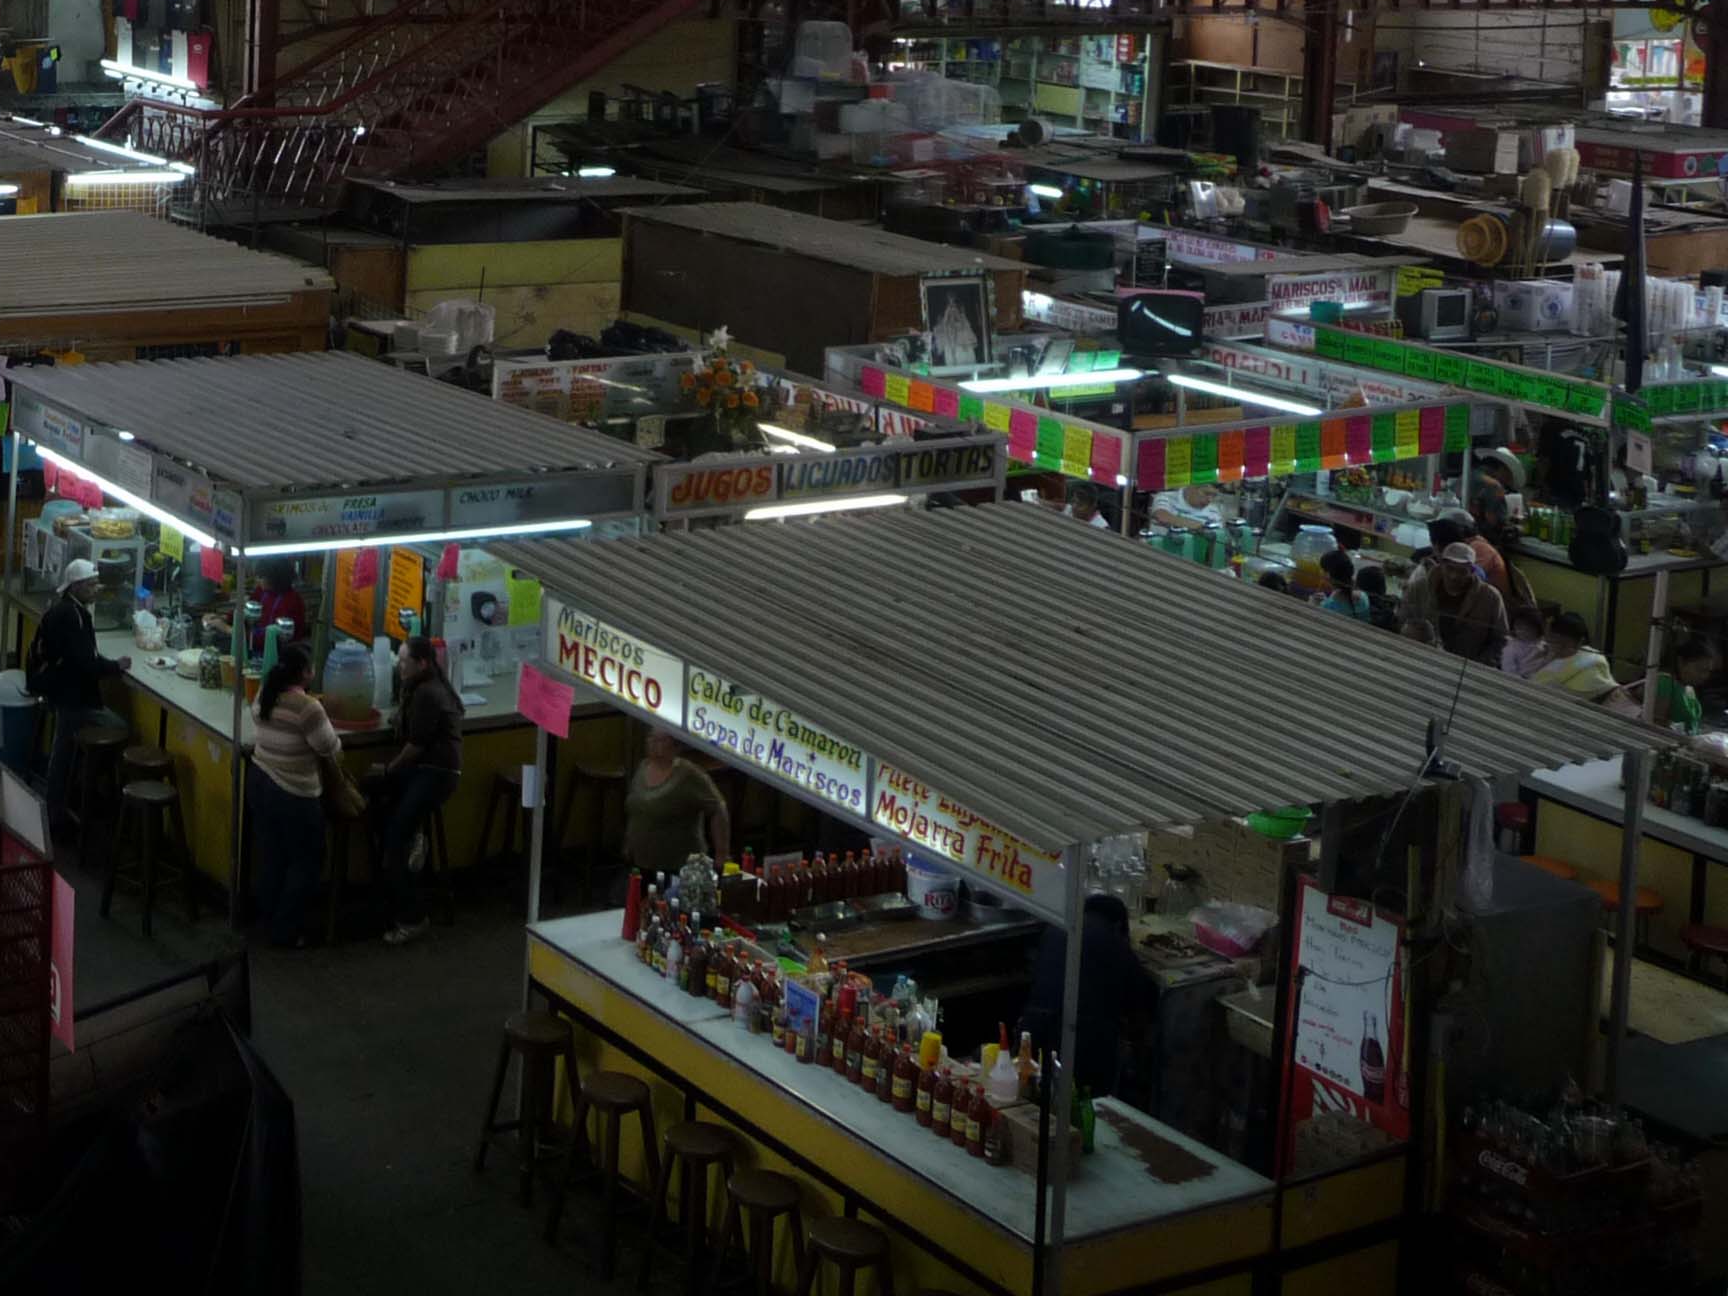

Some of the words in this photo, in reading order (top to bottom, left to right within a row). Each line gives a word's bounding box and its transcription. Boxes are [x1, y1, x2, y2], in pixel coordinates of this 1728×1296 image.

[1273, 279, 1337, 299] MARISCOS
[1348, 276, 1377, 293] MAR
[342, 496, 377, 511] FRESA
[672, 466, 772, 504] JUGOS
[901, 447, 995, 481] TORTAS
[558, 605, 645, 667] Mariscos
[558, 634, 663, 710] MECICO
[690, 672, 745, 714] Caldo
[748, 692, 773, 726] de
[775, 710, 862, 769] Camaron
[692, 707, 739, 749] Sopa
[743, 728, 765, 760] de
[767, 737, 862, 807] Mariscos
[875, 790, 965, 854] Mojarra
[976, 834, 1033, 889] Frita
